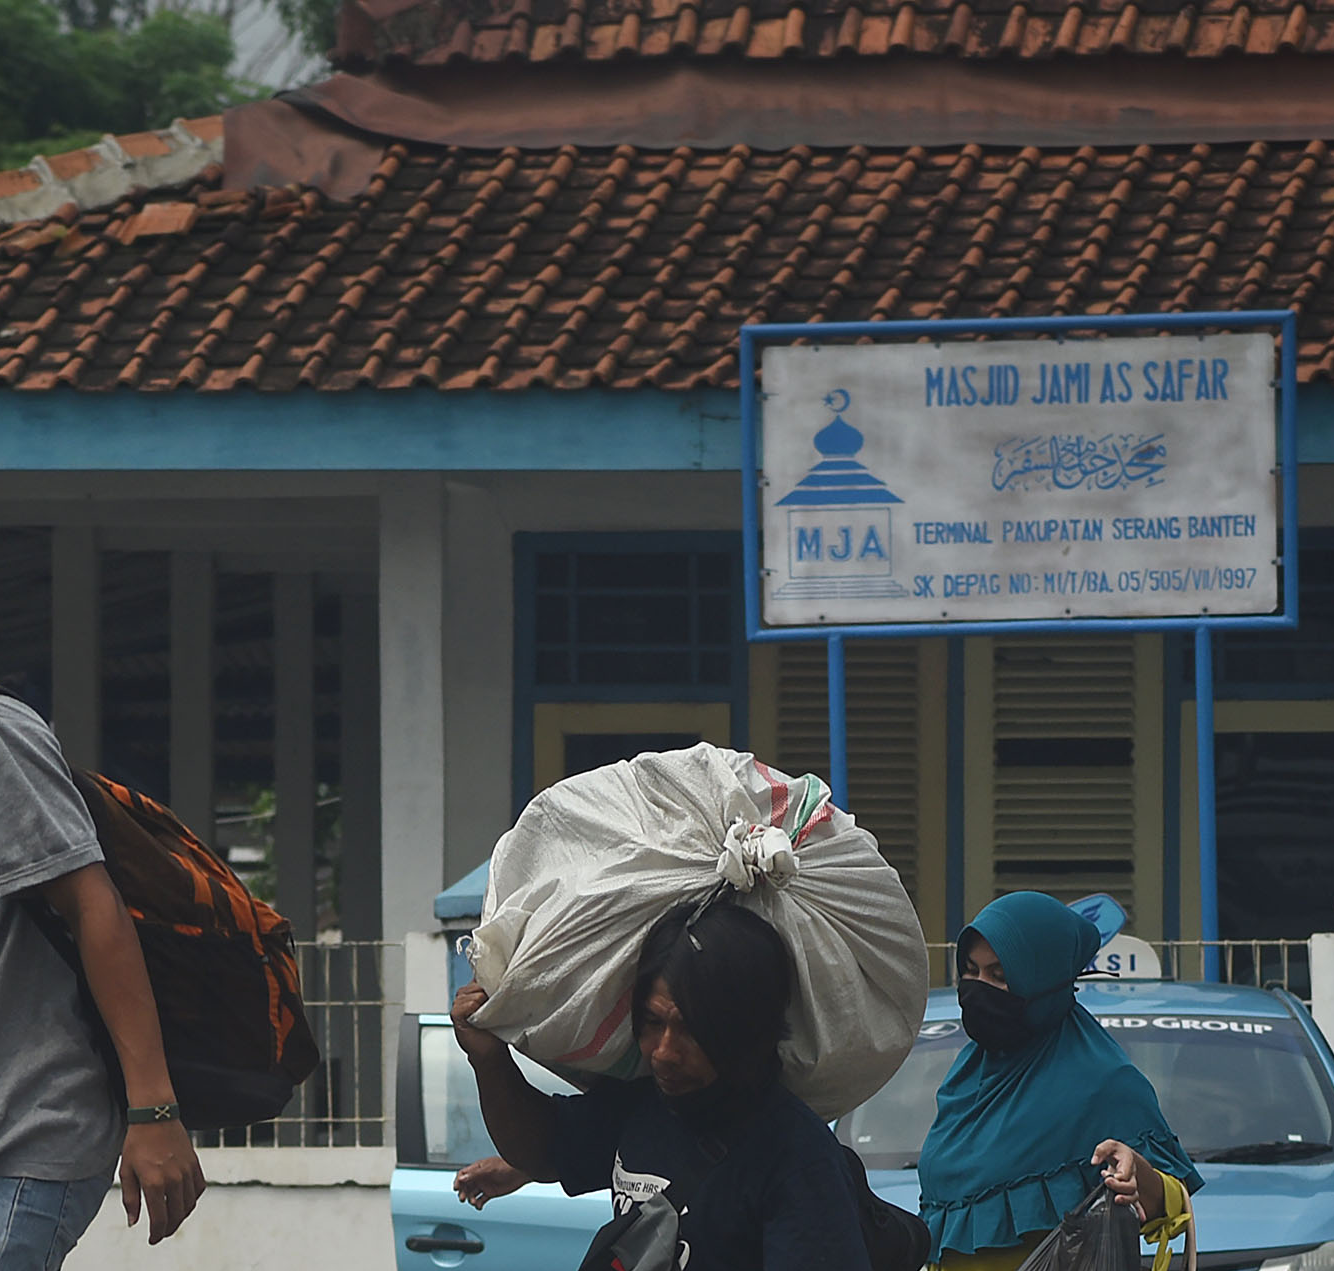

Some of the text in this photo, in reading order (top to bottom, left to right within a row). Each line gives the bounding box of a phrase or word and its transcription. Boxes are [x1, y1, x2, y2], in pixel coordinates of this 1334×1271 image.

[925, 358, 1230, 407] MASJID JAMI AS SAFAR
[795, 525, 889, 562] MJA
[913, 514, 1256, 545] TERMINAL PAKUPATAN SERANG BANTEN
[913, 575, 935, 598] SK
[943, 573, 1001, 598] DEPAG
[1152, 1016, 1273, 1034] GROUP
